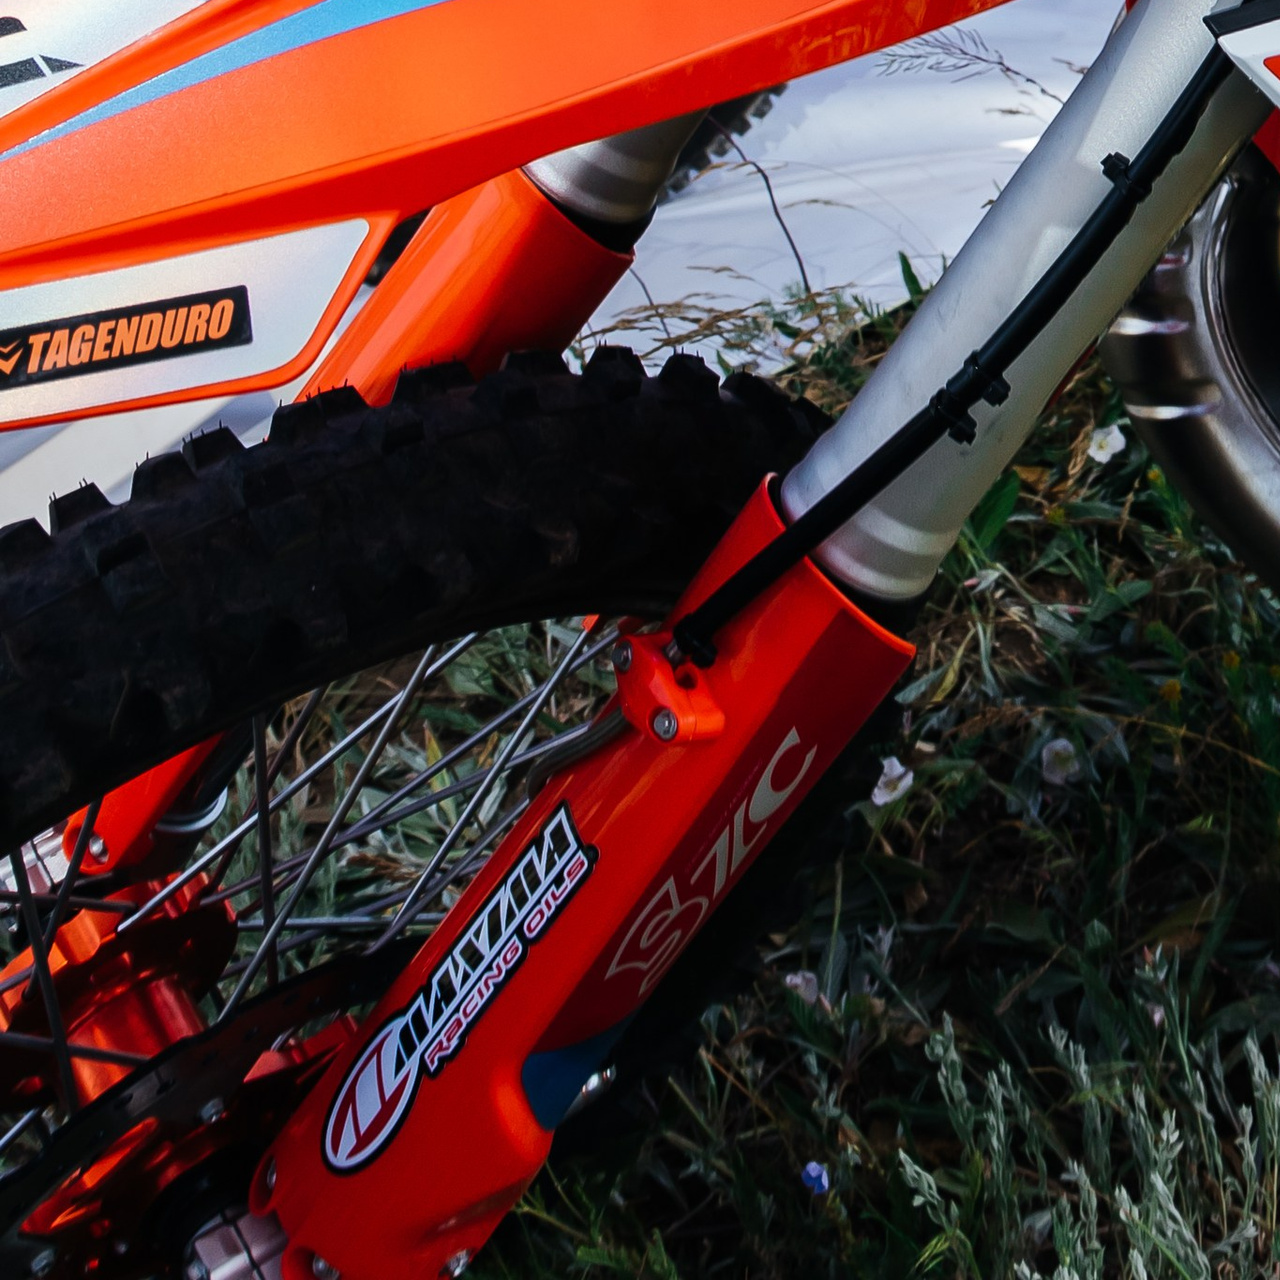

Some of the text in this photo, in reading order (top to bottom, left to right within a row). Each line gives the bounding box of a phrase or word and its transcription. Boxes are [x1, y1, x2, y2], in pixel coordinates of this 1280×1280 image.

[26, 297, 236, 376] TAGENDURO
[424, 853, 588, 1072] RACING OILS
